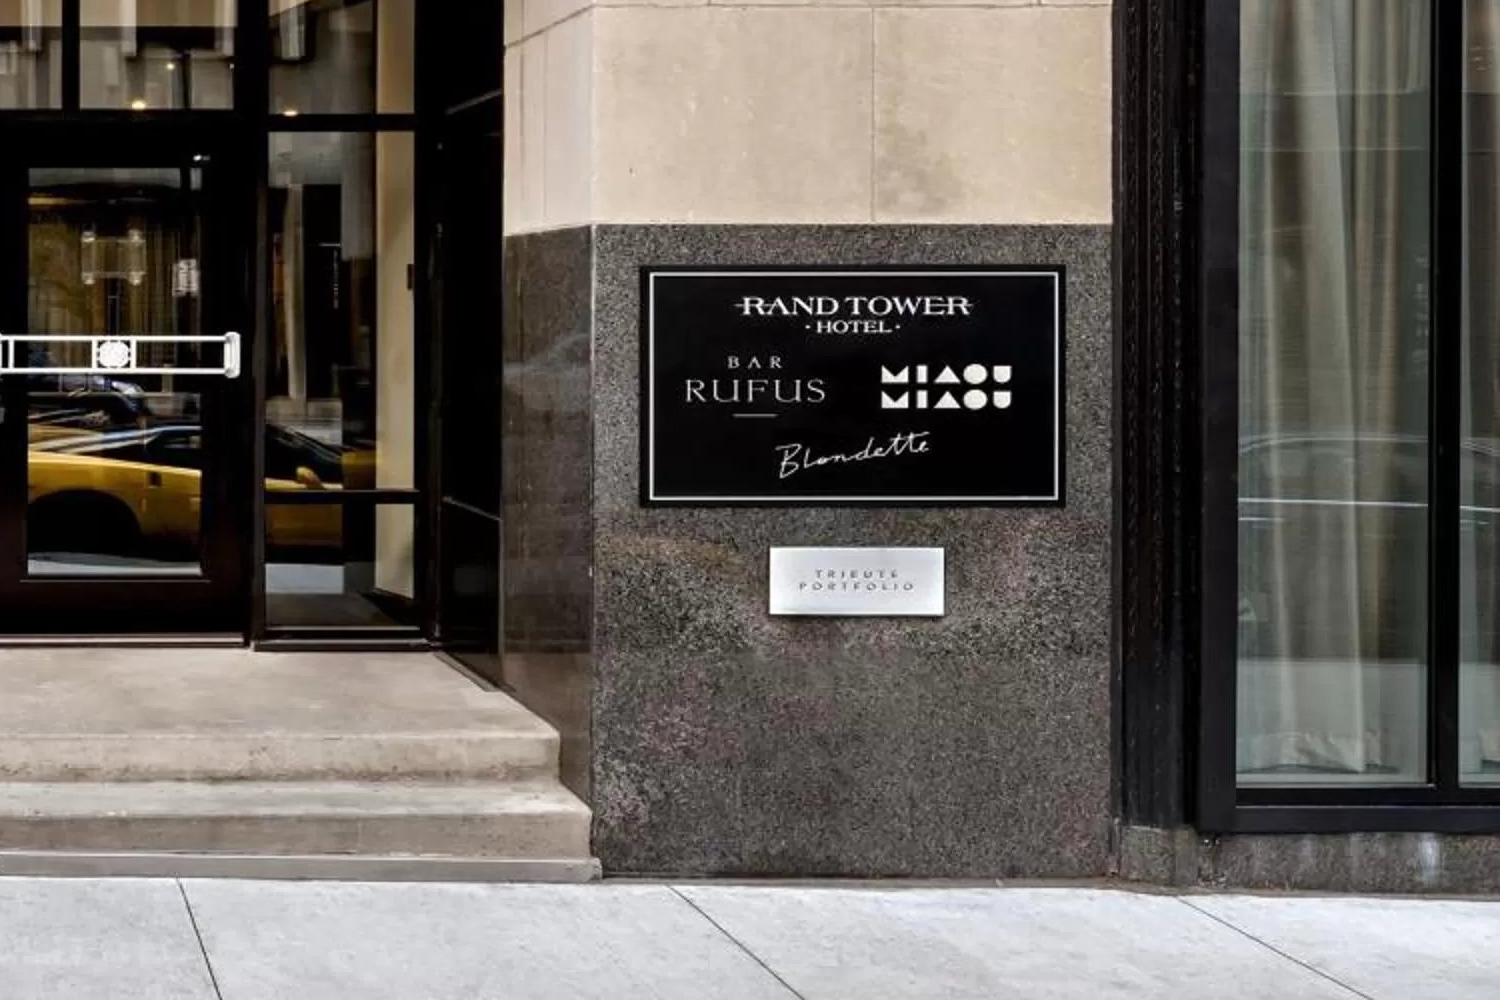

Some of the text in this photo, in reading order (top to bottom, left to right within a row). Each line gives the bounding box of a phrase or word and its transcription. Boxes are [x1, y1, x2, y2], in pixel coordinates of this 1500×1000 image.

[741, 295, 971, 317] RAND TOWER
[816, 319, 893, 334] HOTEL
[727, 355, 783, 370] BAR
[880, 363, 1013, 385] MIAOU
[685, 379, 827, 403] RUFUS
[880, 388, 1013, 411] MIAOU
[774, 431, 931, 479] Blondette
[798, 581, 915, 592] PORTFOLIO
